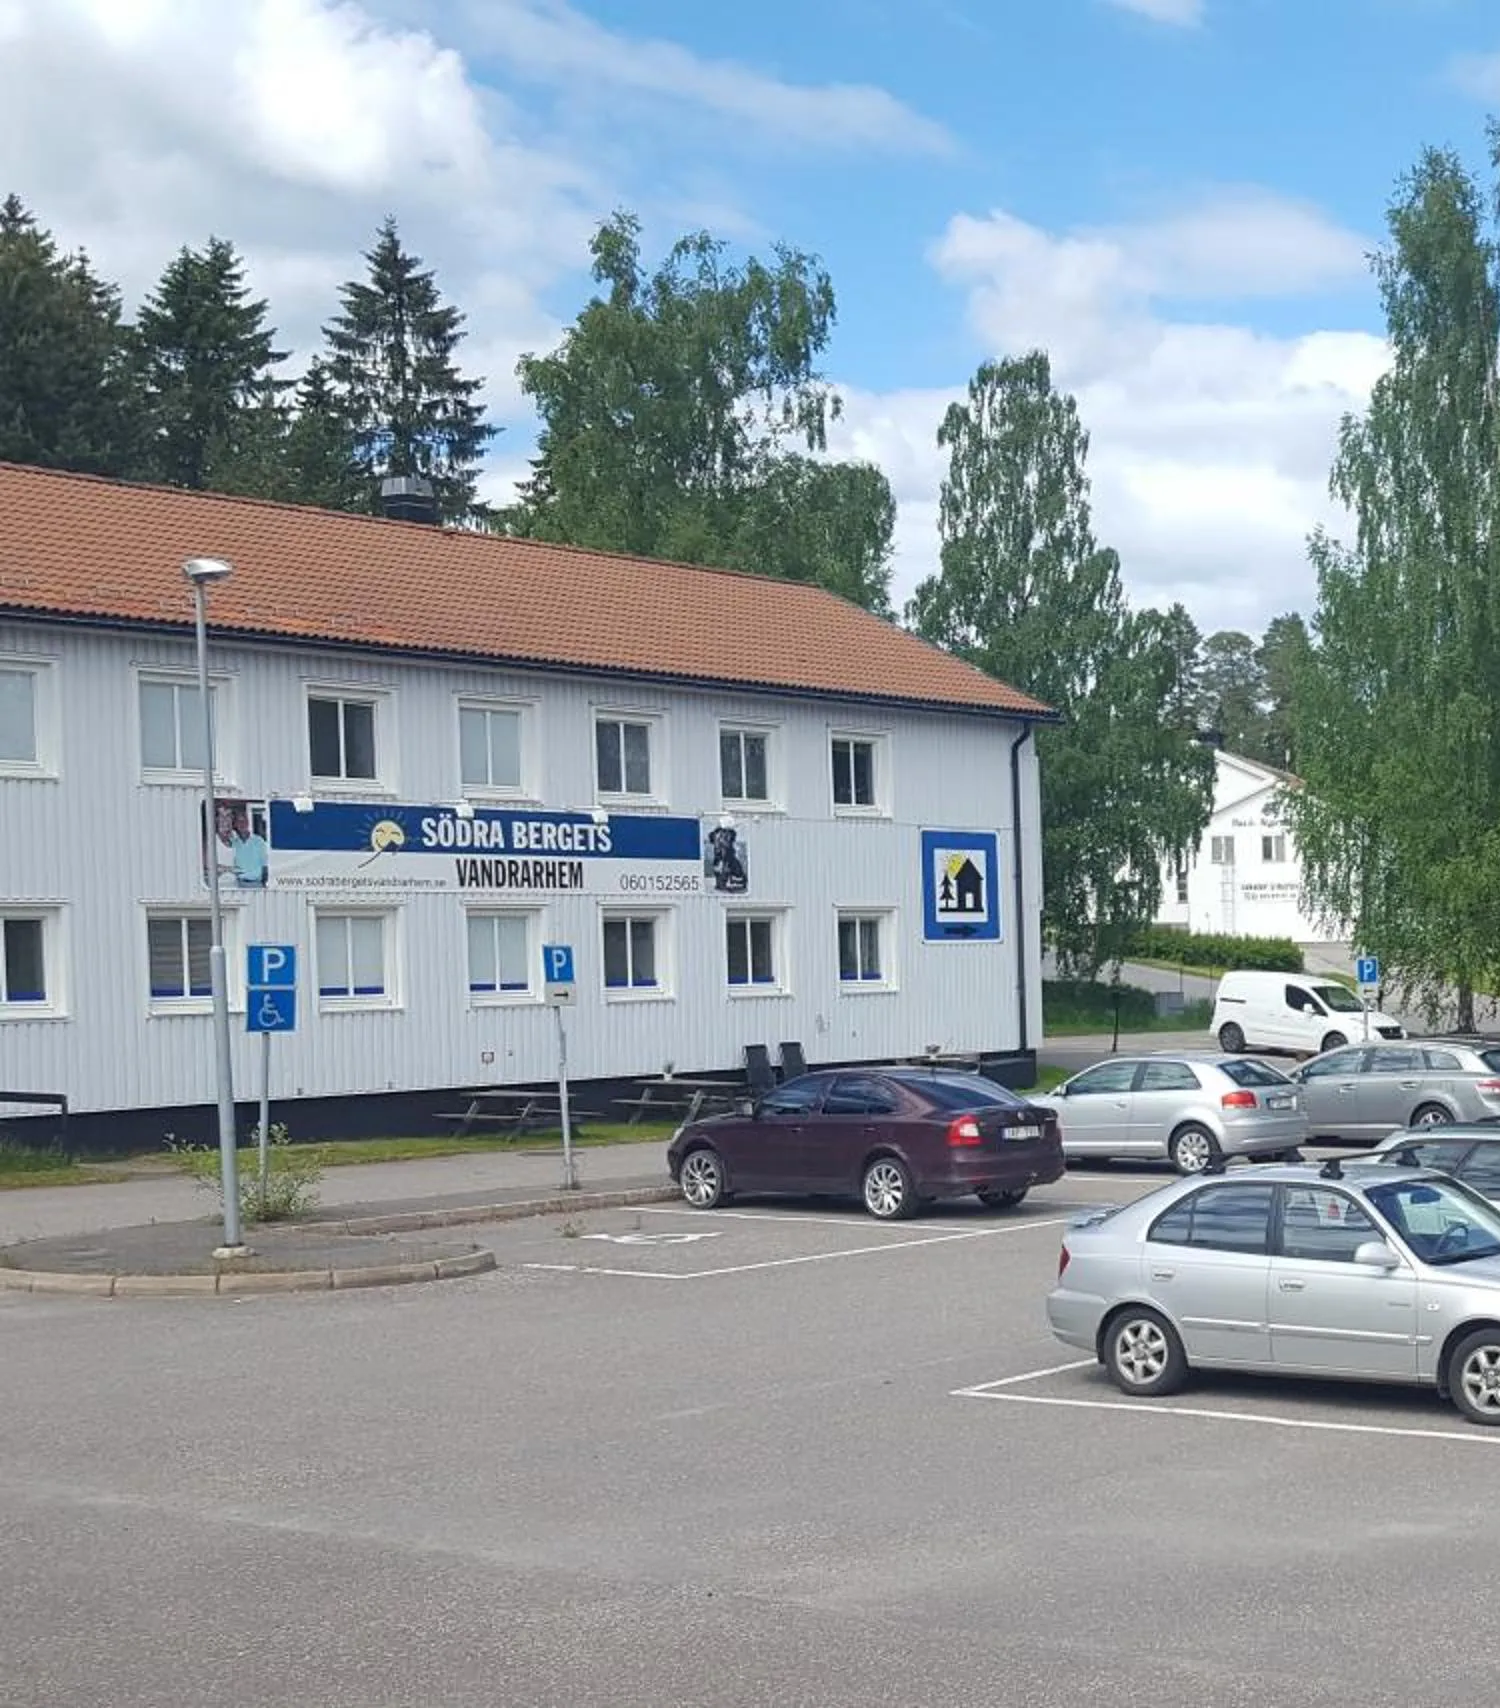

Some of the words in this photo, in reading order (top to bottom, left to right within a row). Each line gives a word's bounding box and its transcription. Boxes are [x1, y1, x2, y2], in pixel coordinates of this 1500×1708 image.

[421, 813, 505, 848] SÖDRA
[512, 821, 612, 852] BERGETS
[456, 858, 584, 889] VANDRARHEM
[619, 873, 700, 891] 060152565
[262, 947, 285, 982] P
[552, 949, 567, 979] P
[1363, 961, 1374, 980] P
